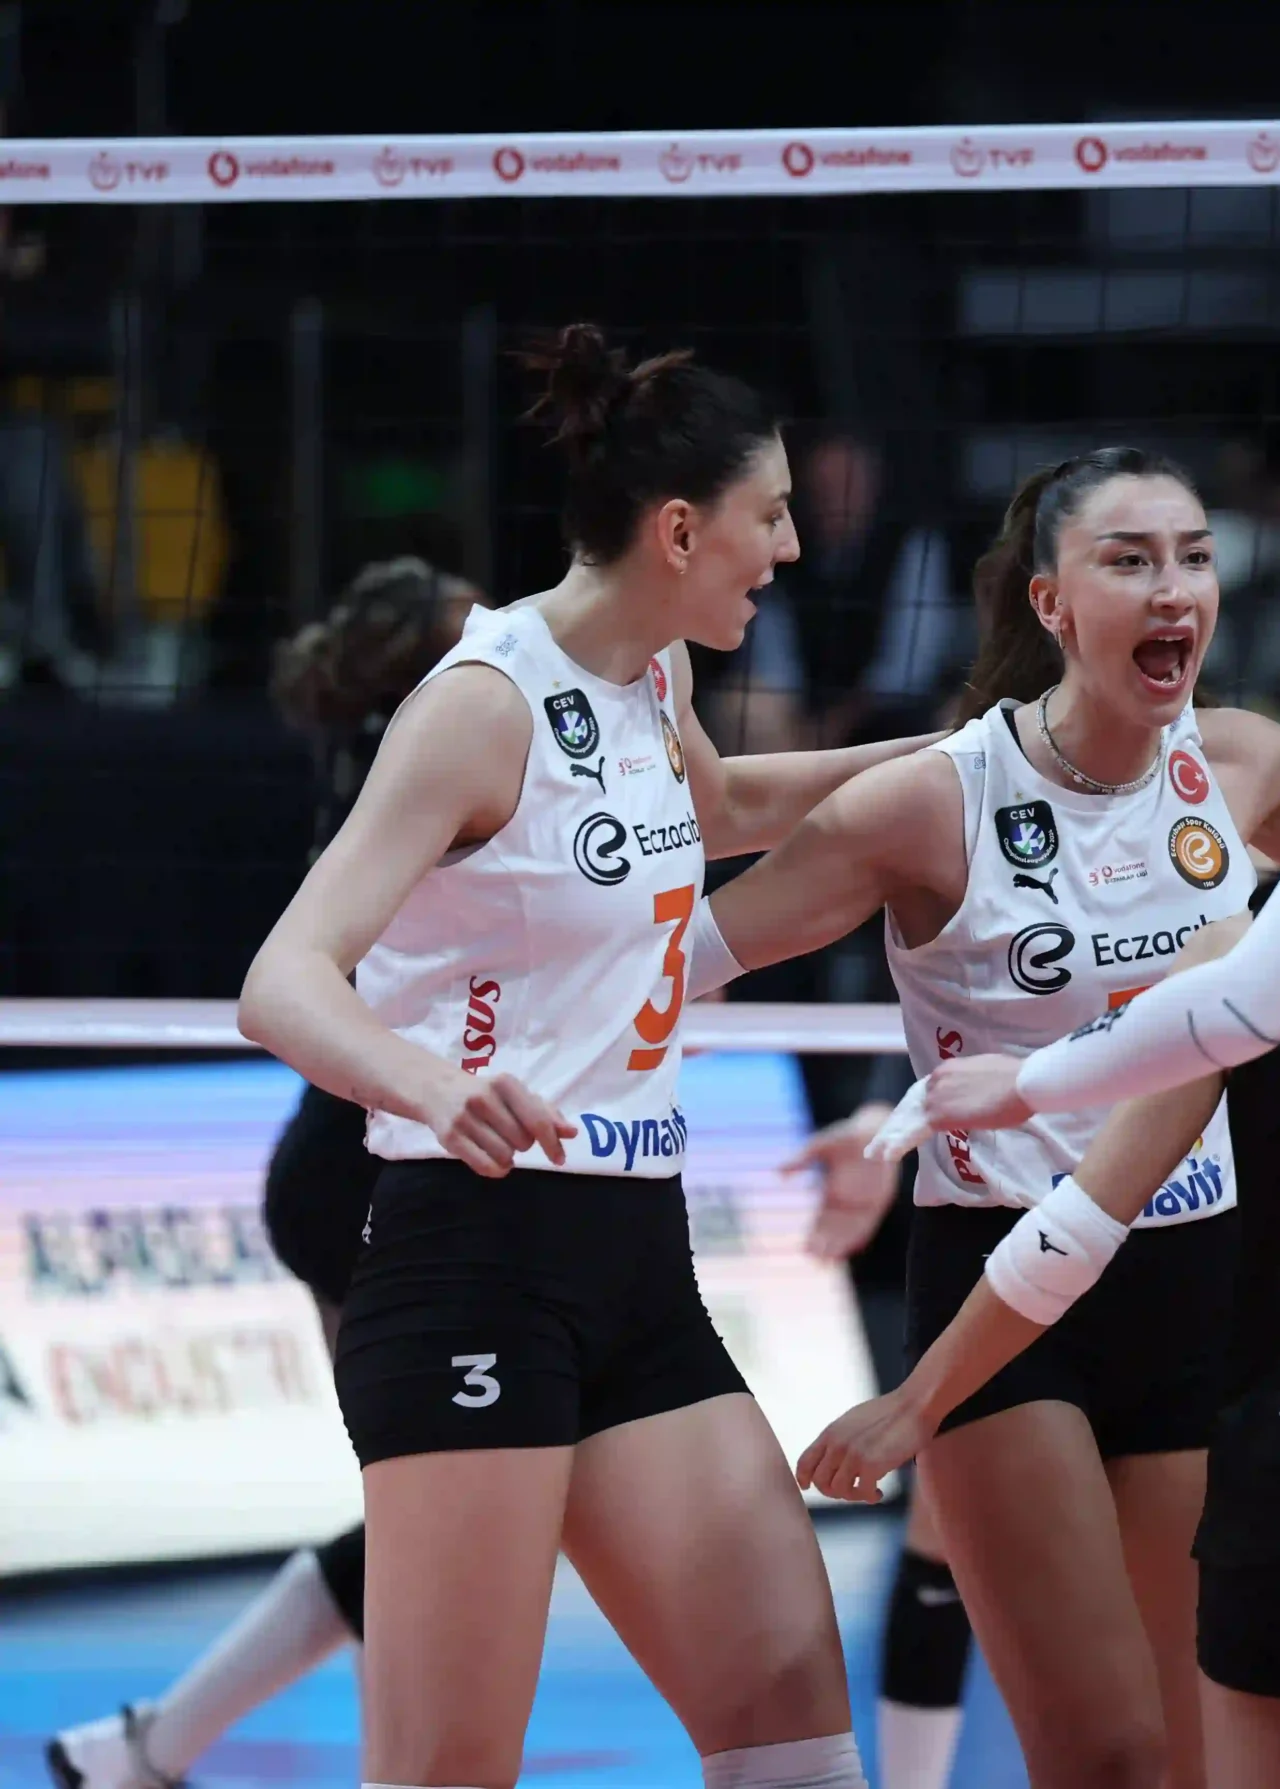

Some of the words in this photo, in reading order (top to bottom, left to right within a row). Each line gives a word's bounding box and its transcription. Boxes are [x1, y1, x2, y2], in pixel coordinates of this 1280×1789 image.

[530, 153, 622, 173] vodafone
[697, 152, 742, 173] TVF
[820, 147, 912, 168] vodafone
[988, 148, 1034, 168] TVF
[1112, 142, 1208, 164] vodafone
[0, 162, 51, 181] afone
[244, 157, 335, 178] vodafone
[553, 695, 574, 710] CEV
[1010, 807, 1035, 820] CEV
[461, 976, 500, 1075] ASUS
[452, 1354, 501, 1408] 3
